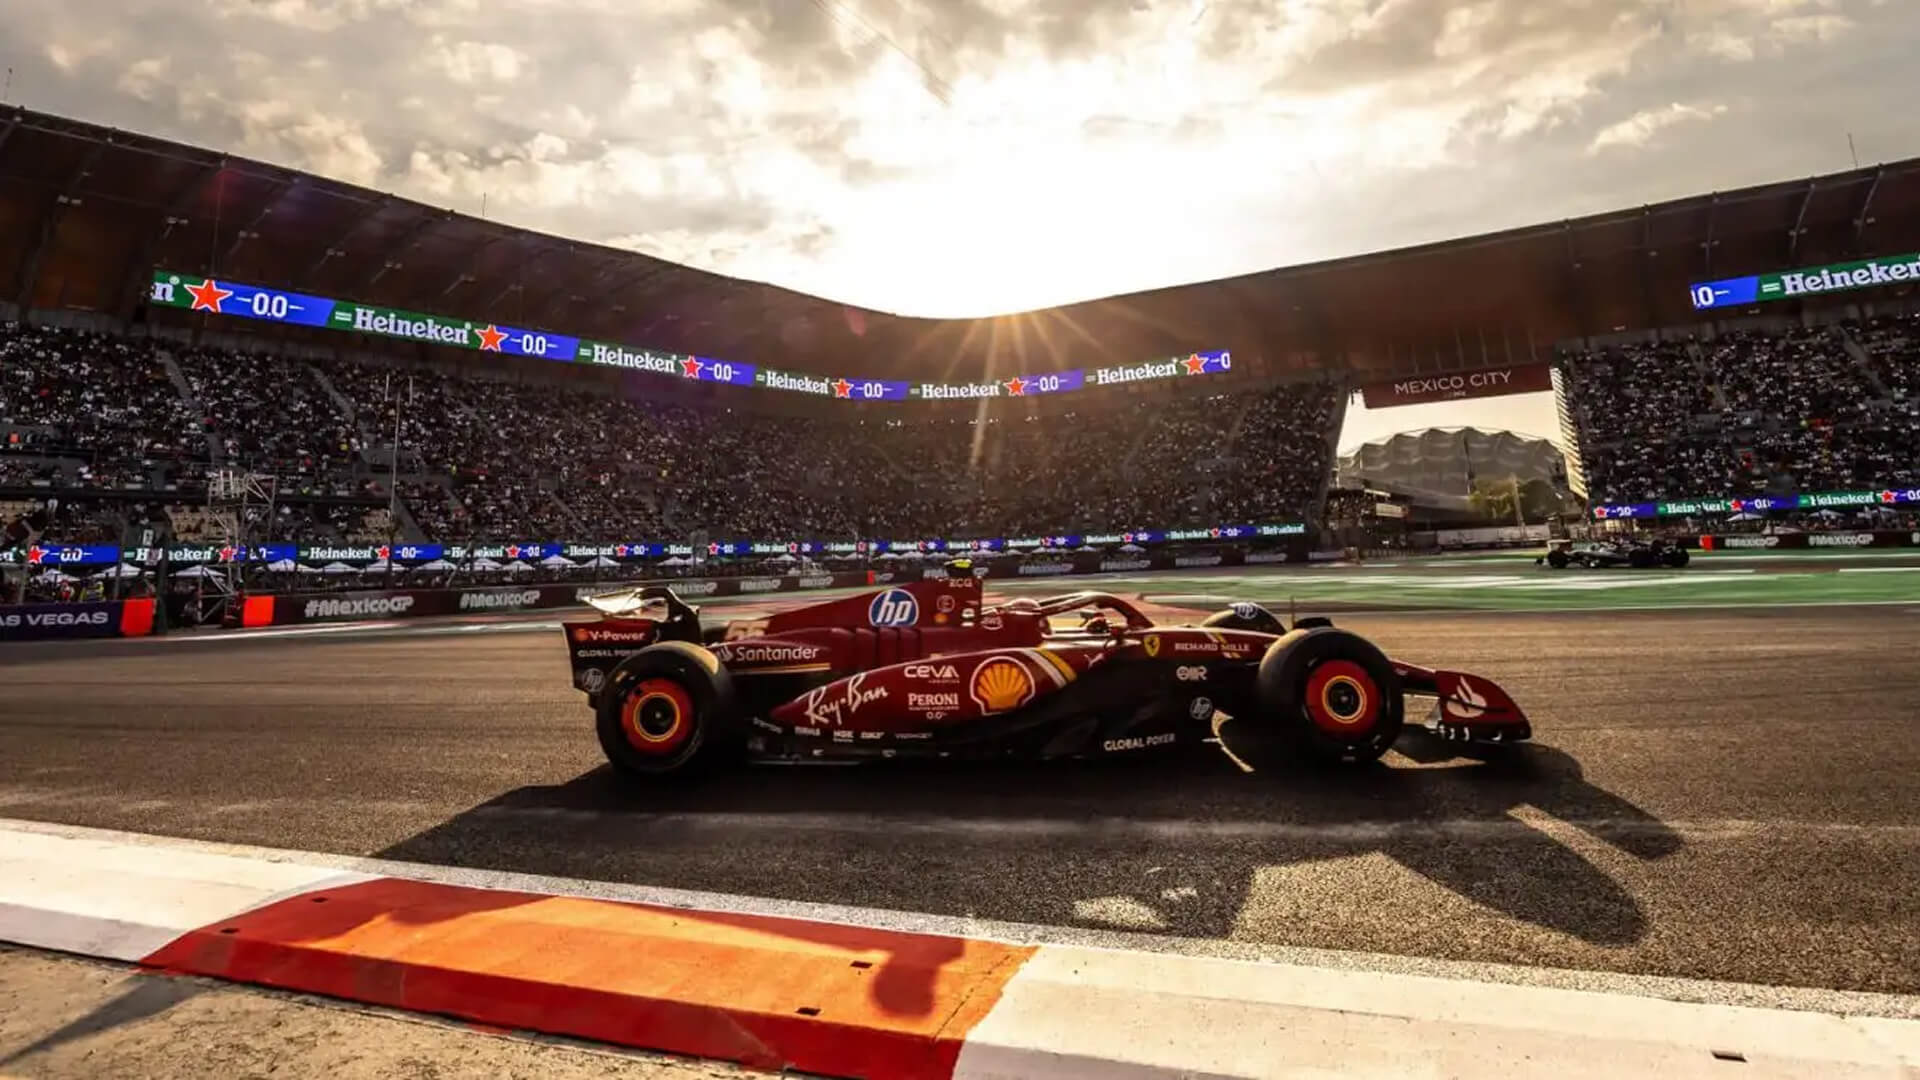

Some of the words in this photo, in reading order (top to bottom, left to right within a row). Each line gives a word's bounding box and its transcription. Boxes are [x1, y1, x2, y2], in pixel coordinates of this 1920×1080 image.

[354, 307, 470, 346] Heineken
[593, 343, 677, 374] Heineken
[766, 370, 829, 396] Heineken
[921, 380, 1000, 400] Heineken
[1096, 359, 1178, 385] Heineken
[1394, 376, 1465, 396] MEXICO
[1469, 370, 1513, 388] CITY
[309, 546, 372, 560] Heineken
[304, 596, 414, 617] #MexicoGP
[460, 590, 541, 609] #MexicoGP
[876, 588, 911, 627] hp
[26, 611, 108, 625] VEGAS
[589, 631, 645, 641] V-Power
[736, 646, 818, 662] Santander
[904, 665, 960, 678] CEVA
[804, 673, 889, 725] Ray-Ban
[908, 692, 959, 706] PERONI
[1104, 737, 1144, 751] GLOBAL
[1146, 733, 1175, 745] POKER
